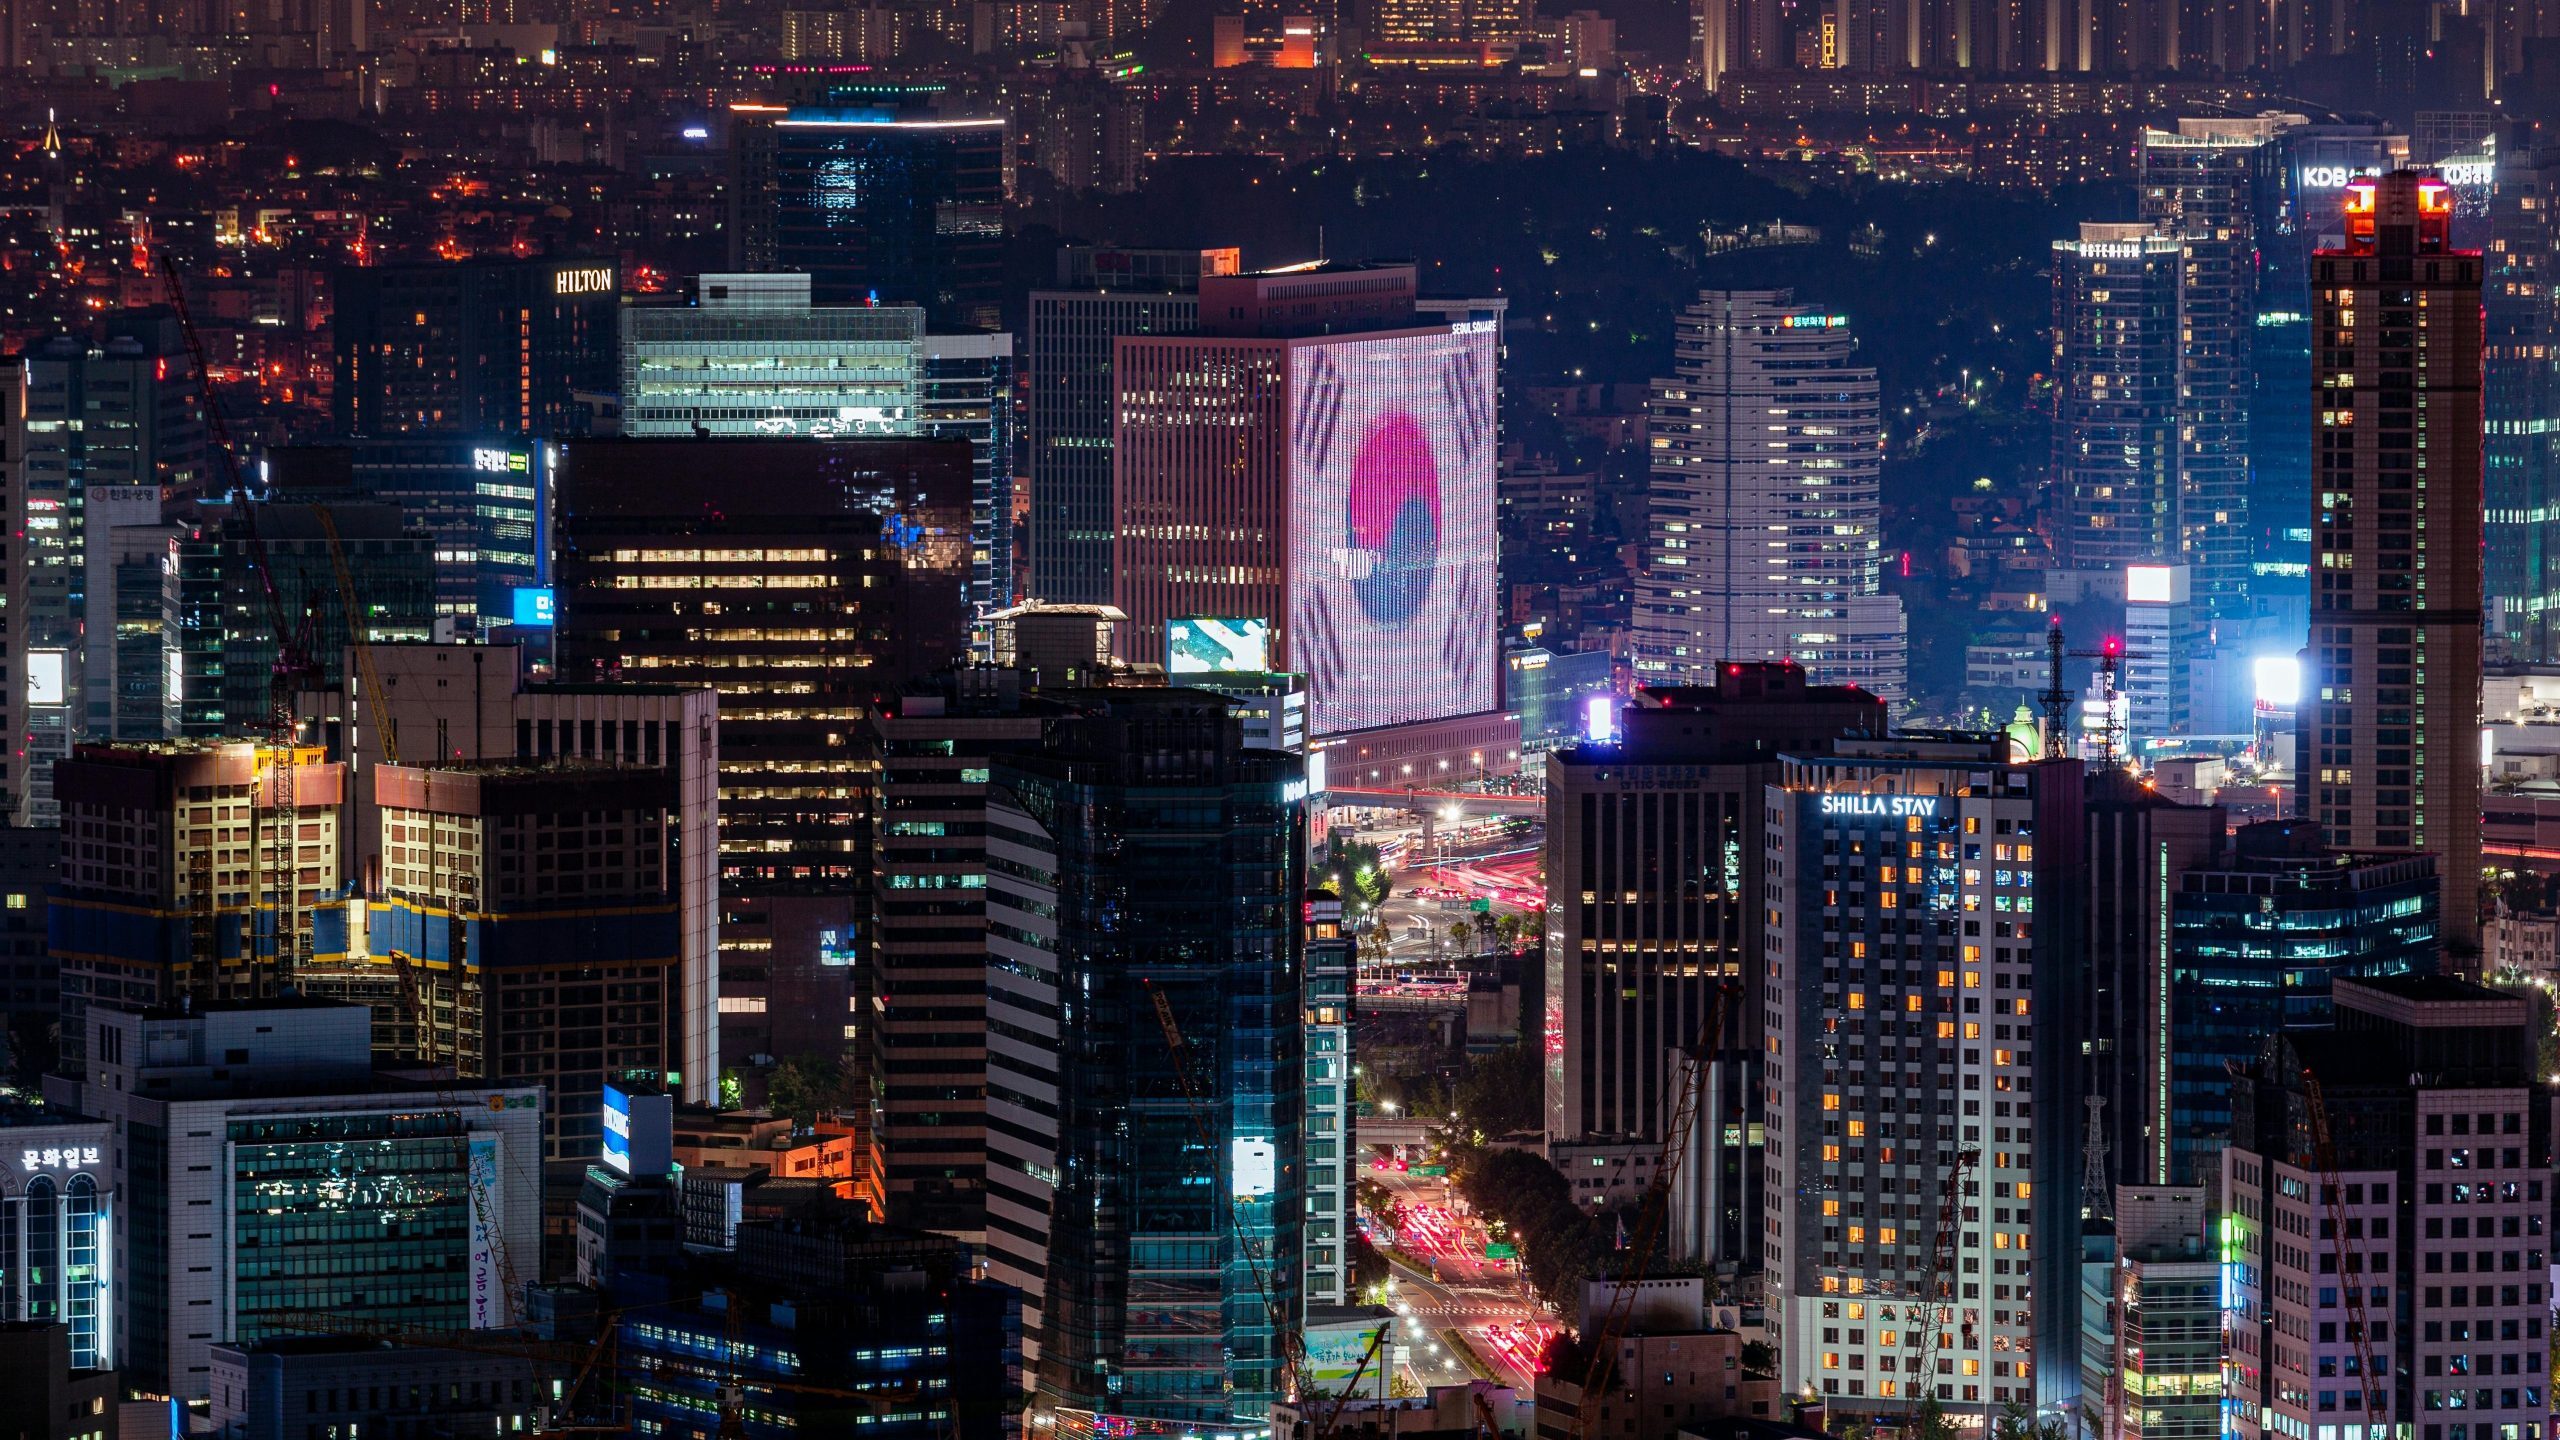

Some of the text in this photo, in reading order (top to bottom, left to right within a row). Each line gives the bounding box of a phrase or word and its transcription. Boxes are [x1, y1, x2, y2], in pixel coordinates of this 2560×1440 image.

[557, 268, 611, 293] HILTON
[1452, 320, 1497, 334] SEOUL SQUARE
[1822, 796, 1936, 816] SHILLA STAY
[21, 1147, 101, 1170] 문화일보
